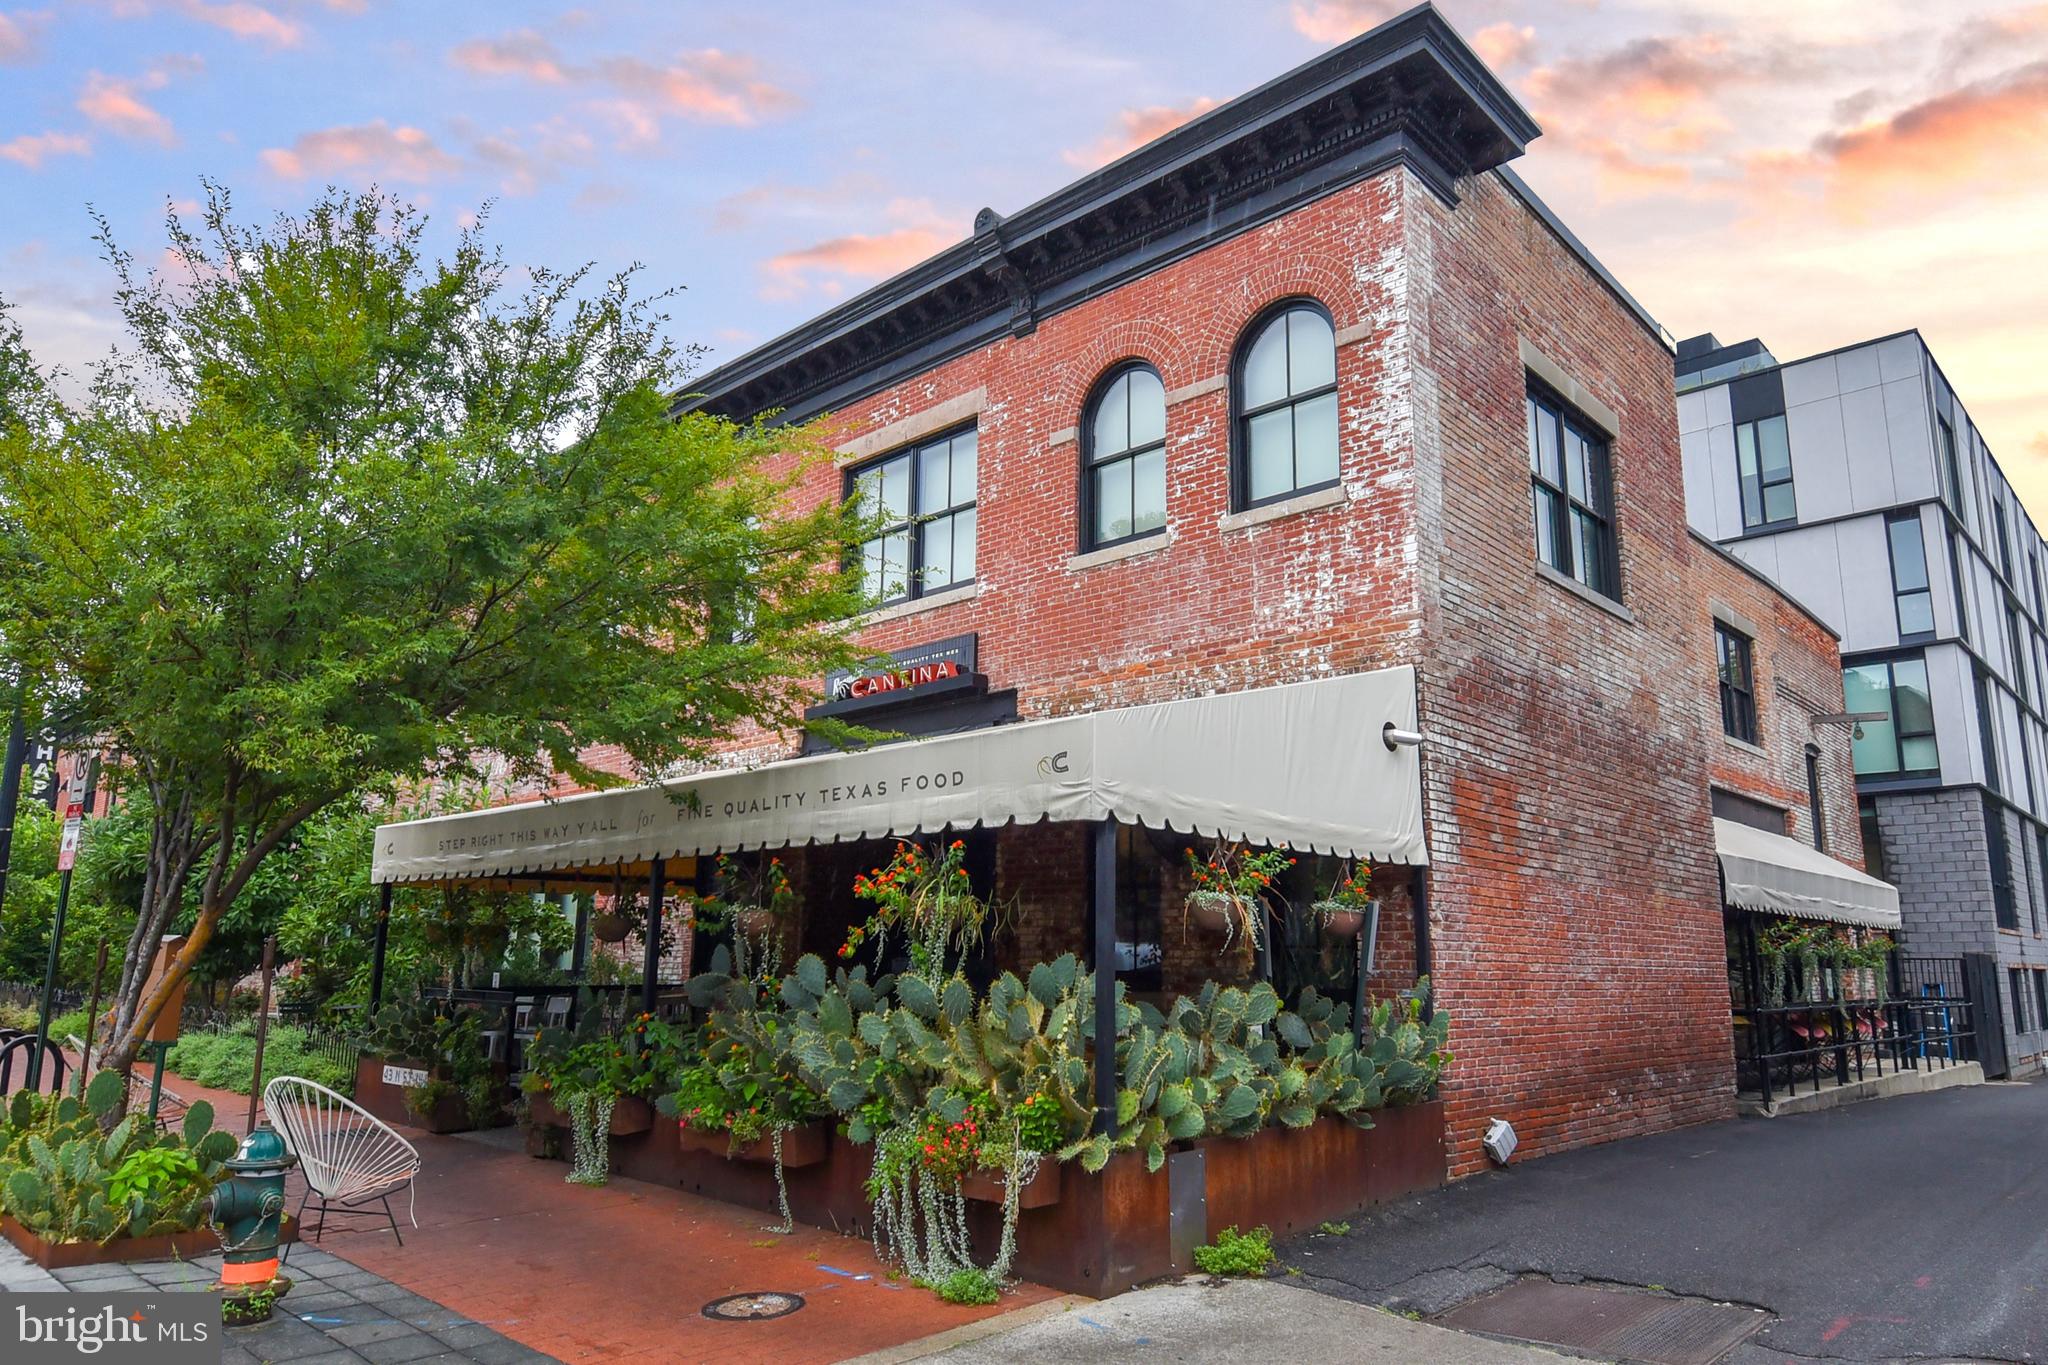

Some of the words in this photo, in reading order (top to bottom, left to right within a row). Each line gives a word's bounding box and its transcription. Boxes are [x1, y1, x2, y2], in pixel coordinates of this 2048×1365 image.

[851, 662, 949, 698] CANTINA
[438, 838, 466, 851] STEP
[471, 833, 504, 848] RIGHT
[510, 830, 537, 843] THIS
[543, 824, 570, 839] WAY
[635, 809, 656, 834] for
[676, 804, 713, 822] FINE
[723, 791, 806, 818] QUALITY
[819, 781, 888, 804] TEXAS
[901, 770, 965, 793] FOOD
